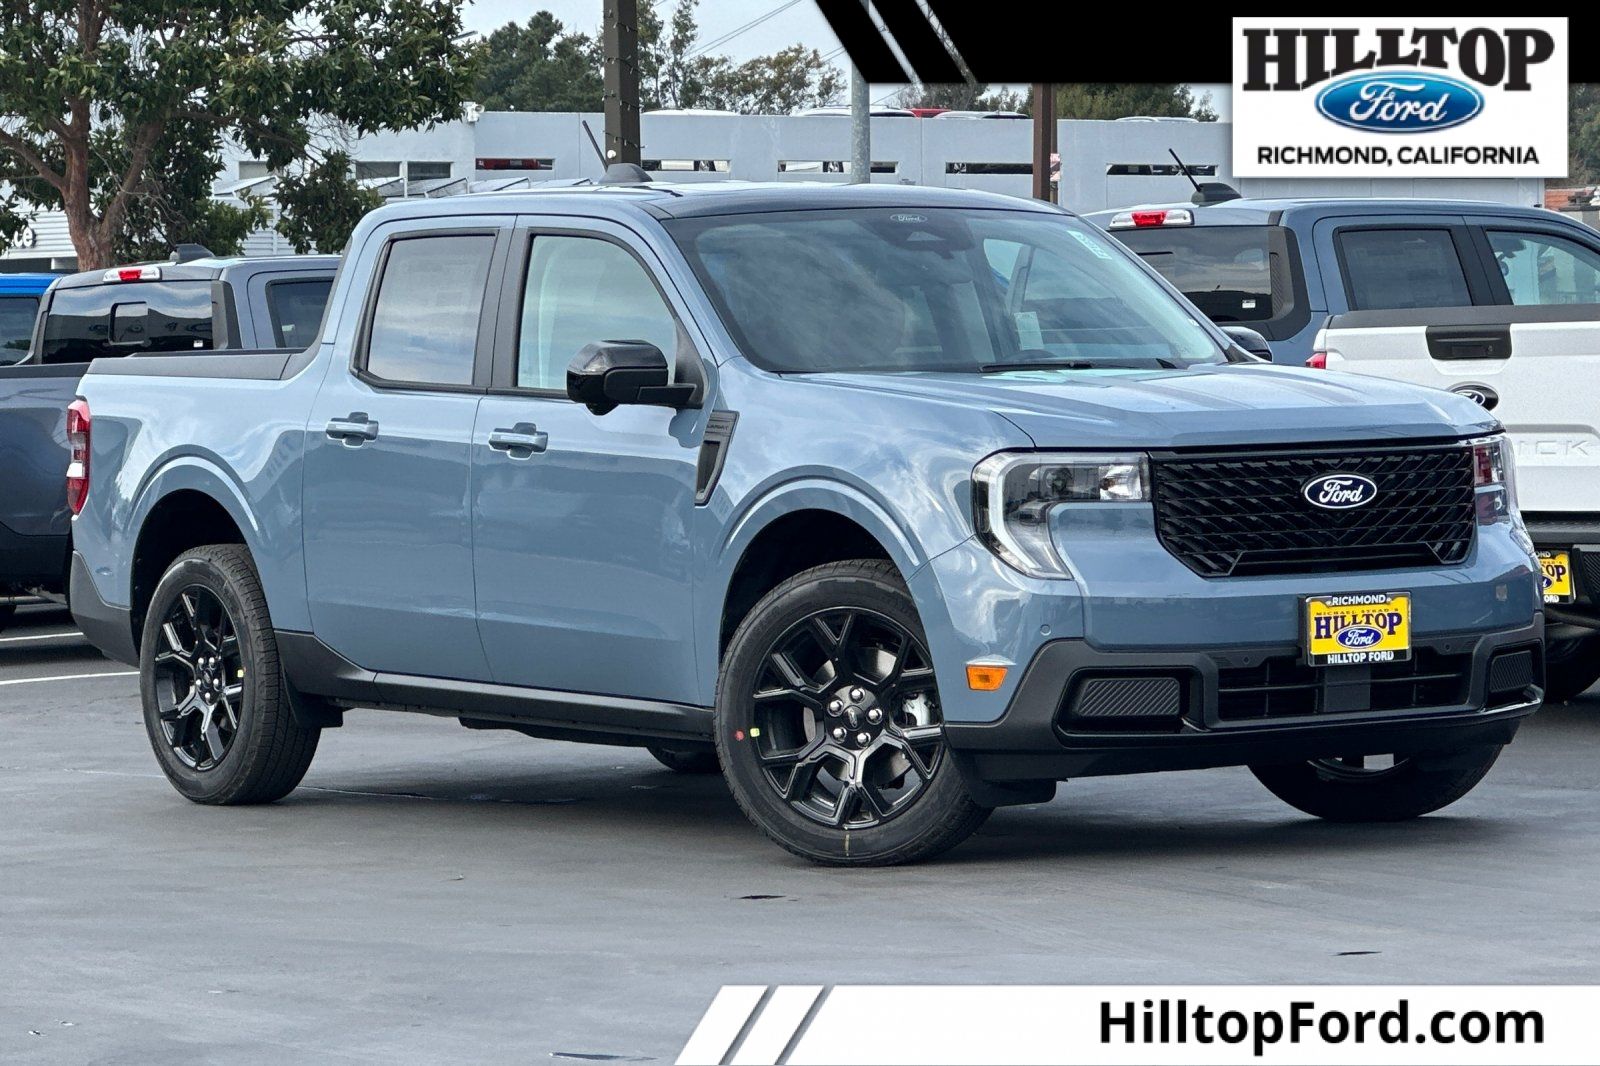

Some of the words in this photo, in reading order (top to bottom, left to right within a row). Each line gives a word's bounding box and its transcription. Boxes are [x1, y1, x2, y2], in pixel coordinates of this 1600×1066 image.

[1319, 479, 1364, 503] Ford
[1332, 594, 1386, 605] RICHMOND
[1314, 612, 1402, 639] HILLTOP
[1345, 629, 1375, 645] Ford
[1328, 653, 1366, 664] HILLTOP
[1370, 651, 1394, 661] FORD
